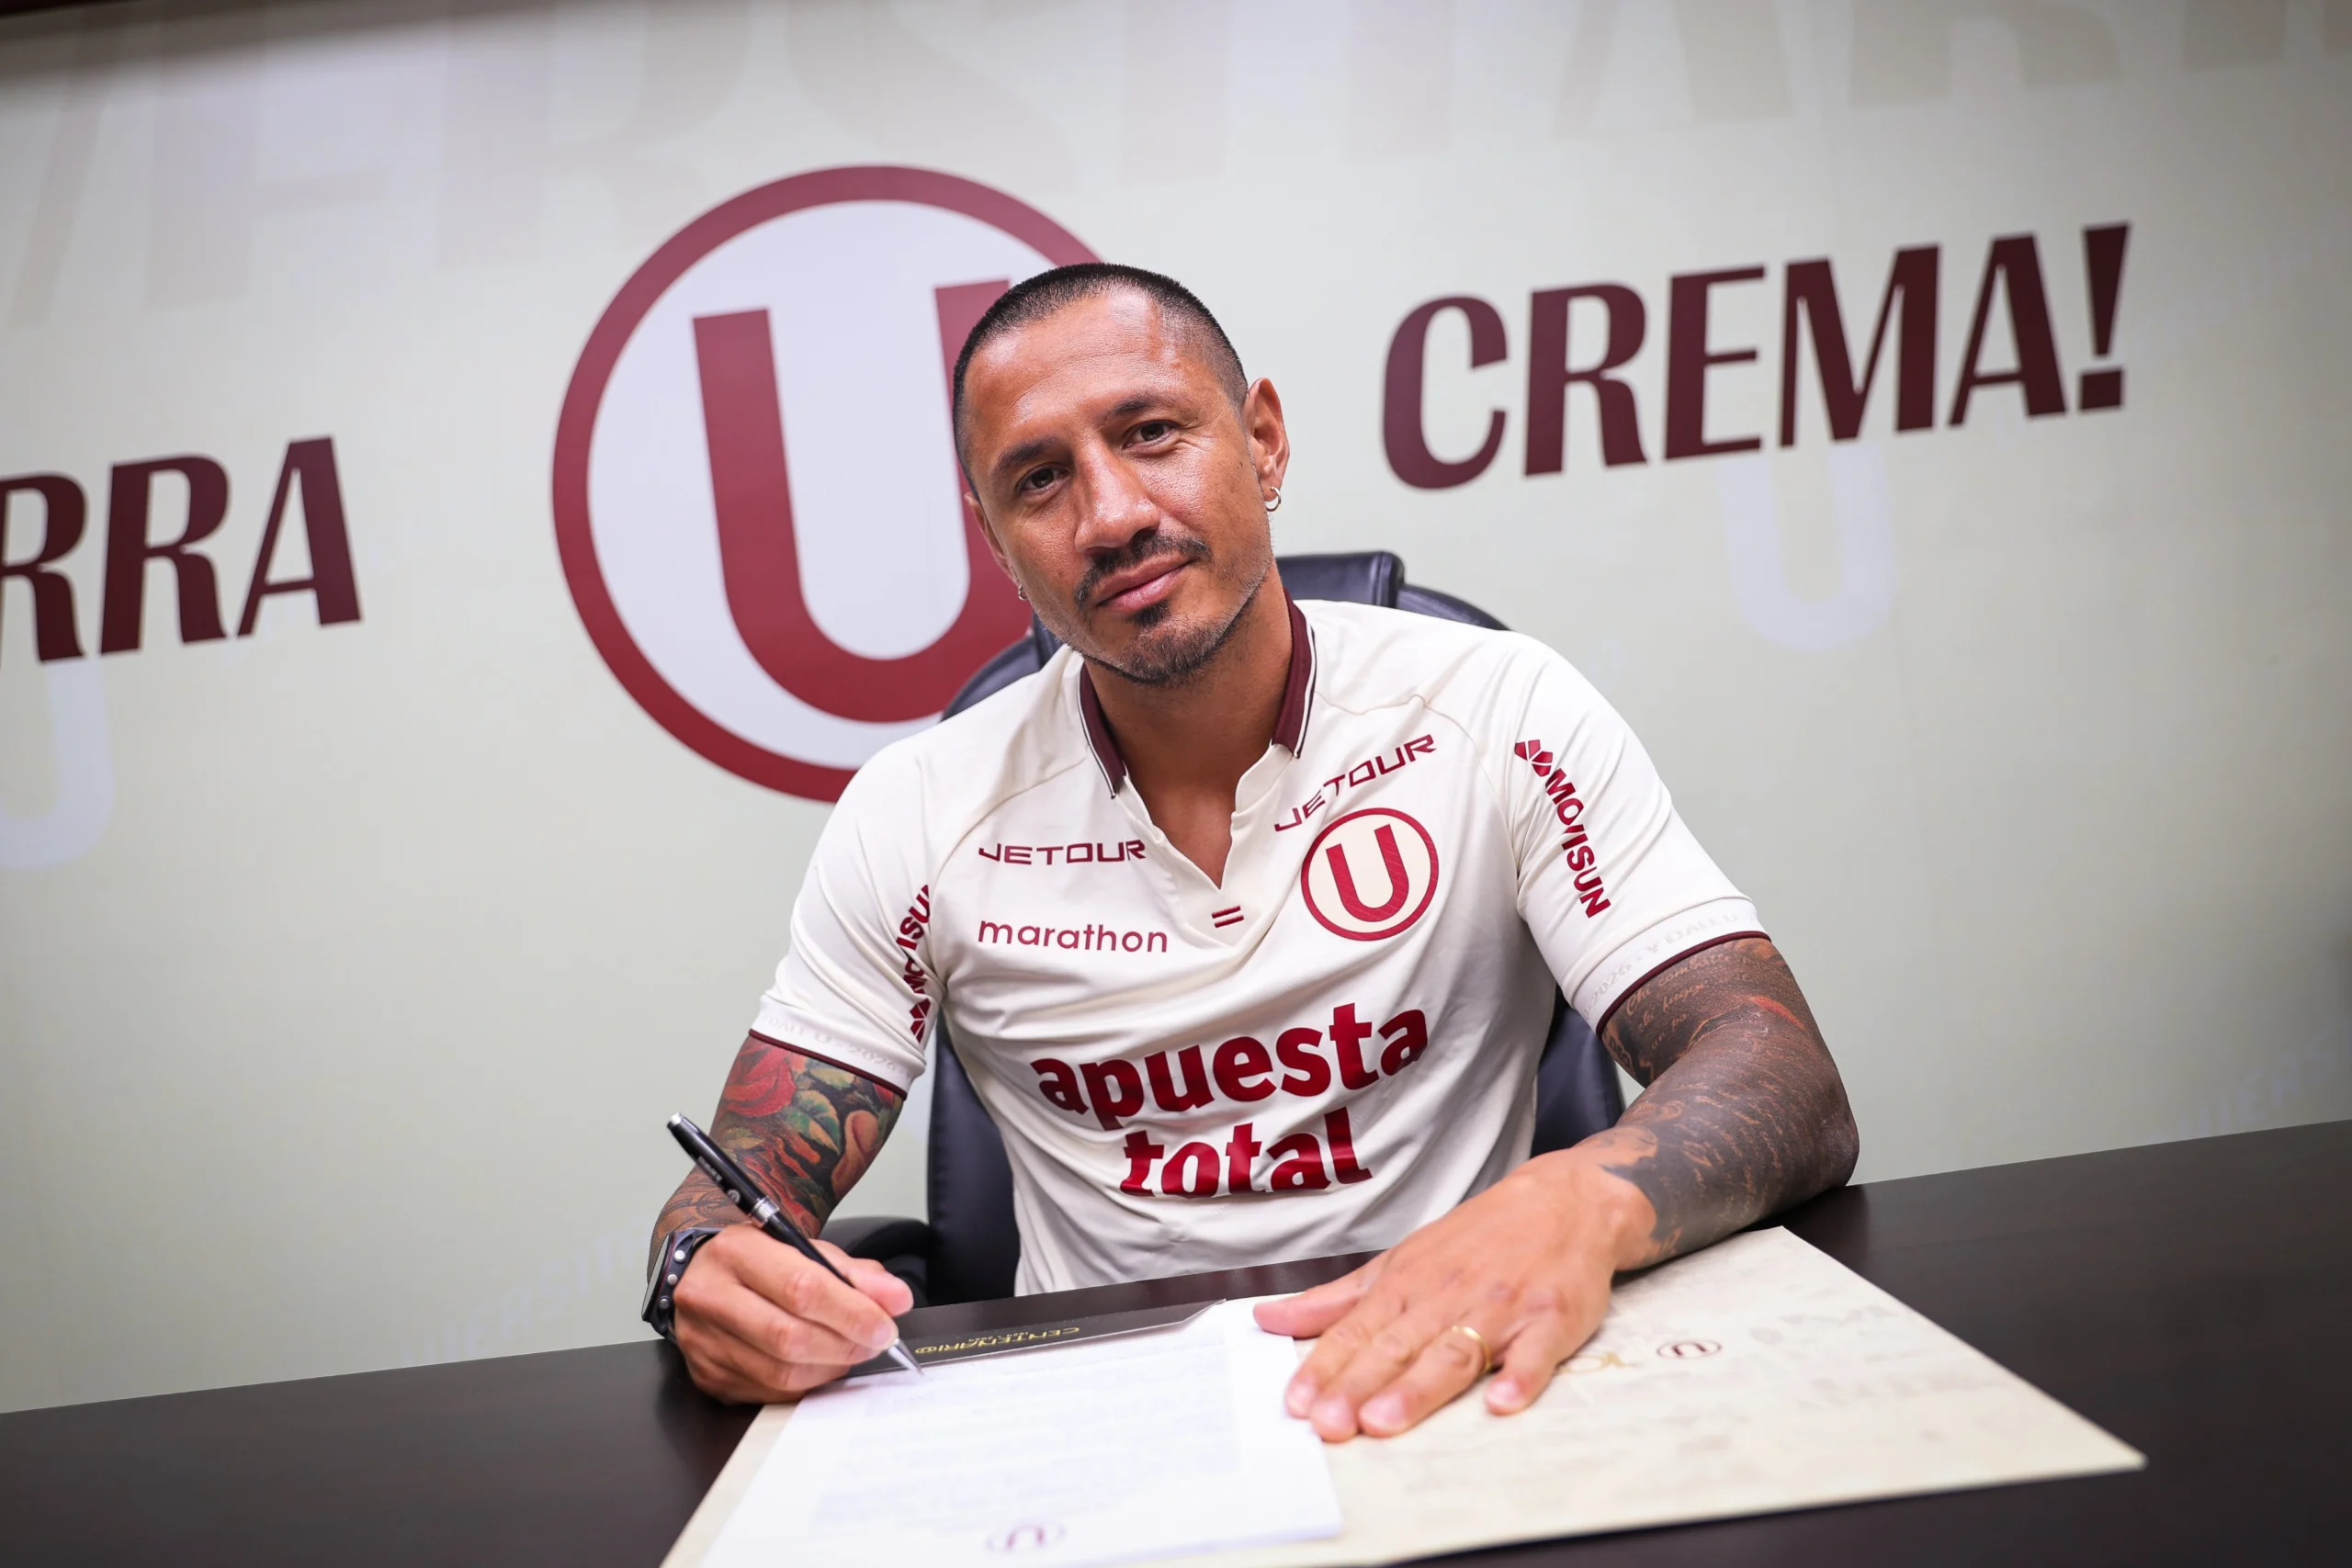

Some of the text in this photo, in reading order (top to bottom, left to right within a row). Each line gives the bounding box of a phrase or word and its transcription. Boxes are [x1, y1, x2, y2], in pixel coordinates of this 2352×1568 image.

[1381, 221, 2131, 491] CREMA!
[692, 279, 1035, 724] U
[1274, 734, 1437, 832] JETOUR
[978, 840, 1147, 865] JETOUR
[1326, 823, 1410, 922] U
[978, 920, 1168, 953] marathon
[1030, 1002, 1429, 1131] apuesta
[1119, 1106, 1373, 1200] total
